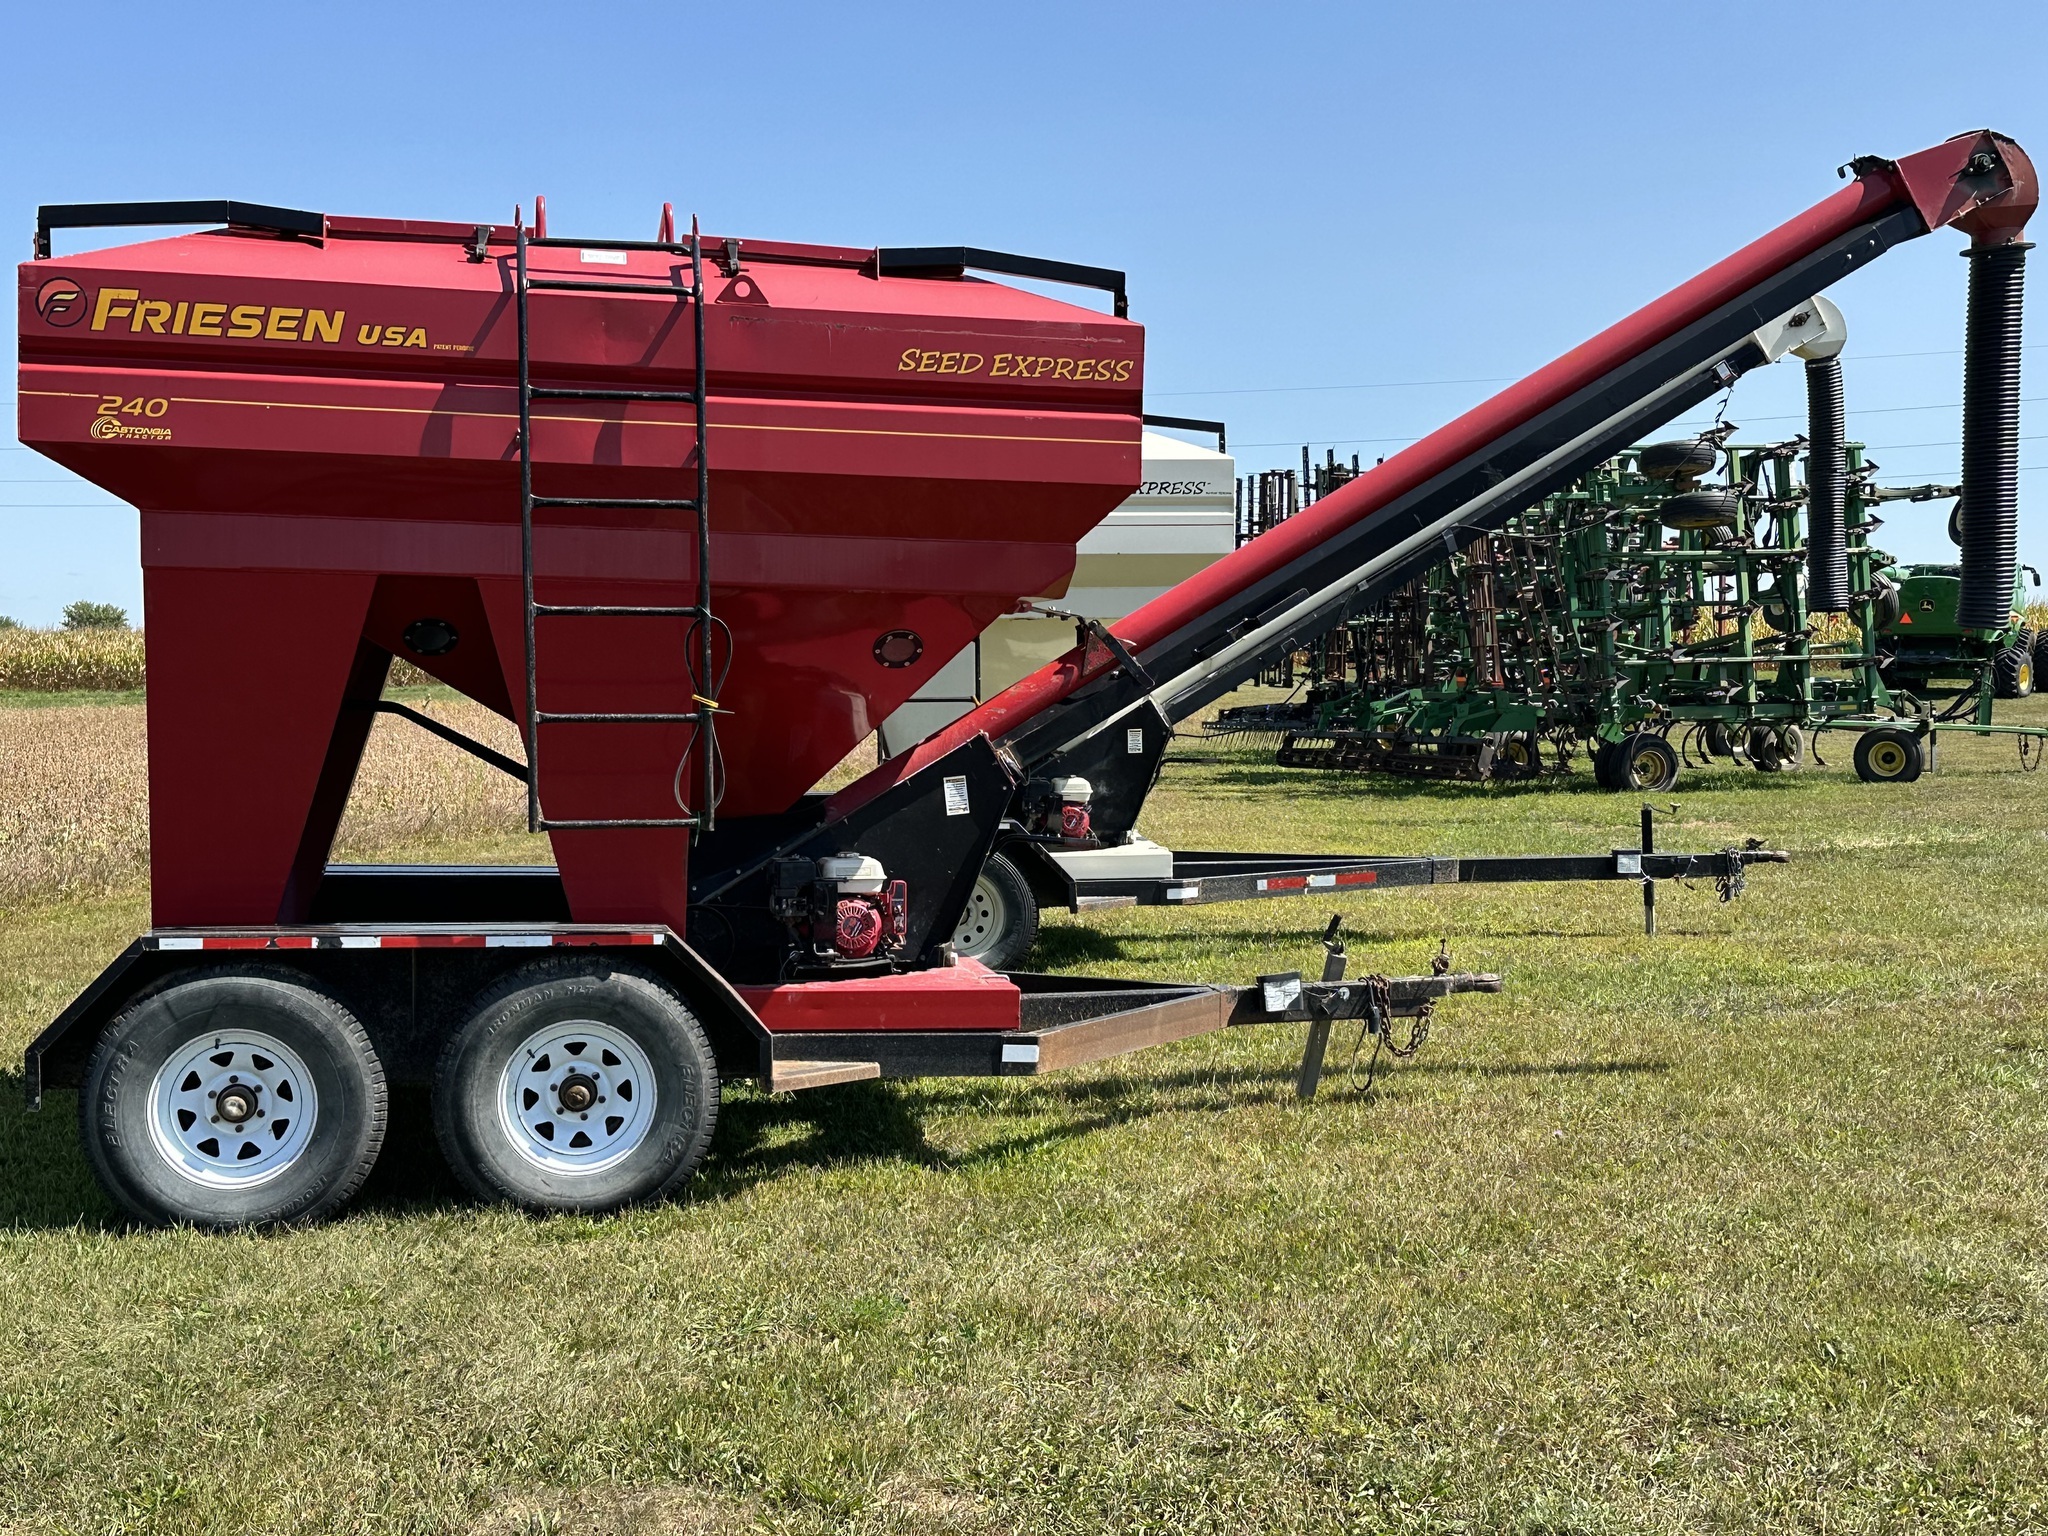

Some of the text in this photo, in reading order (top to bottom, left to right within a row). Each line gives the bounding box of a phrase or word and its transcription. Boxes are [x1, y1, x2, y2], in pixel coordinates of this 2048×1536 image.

[90, 287, 428, 348] FRIESEN USA
[897, 348, 1134, 382] SEED EXPRESS
[96, 395, 169, 417] 240
[1138, 481, 1206, 495] XPRESS
[486, 988, 554, 1037] IRONMAN
[103, 1040, 140, 1148] ELECTRA
[663, 1063, 696, 1166] ELECTRA
